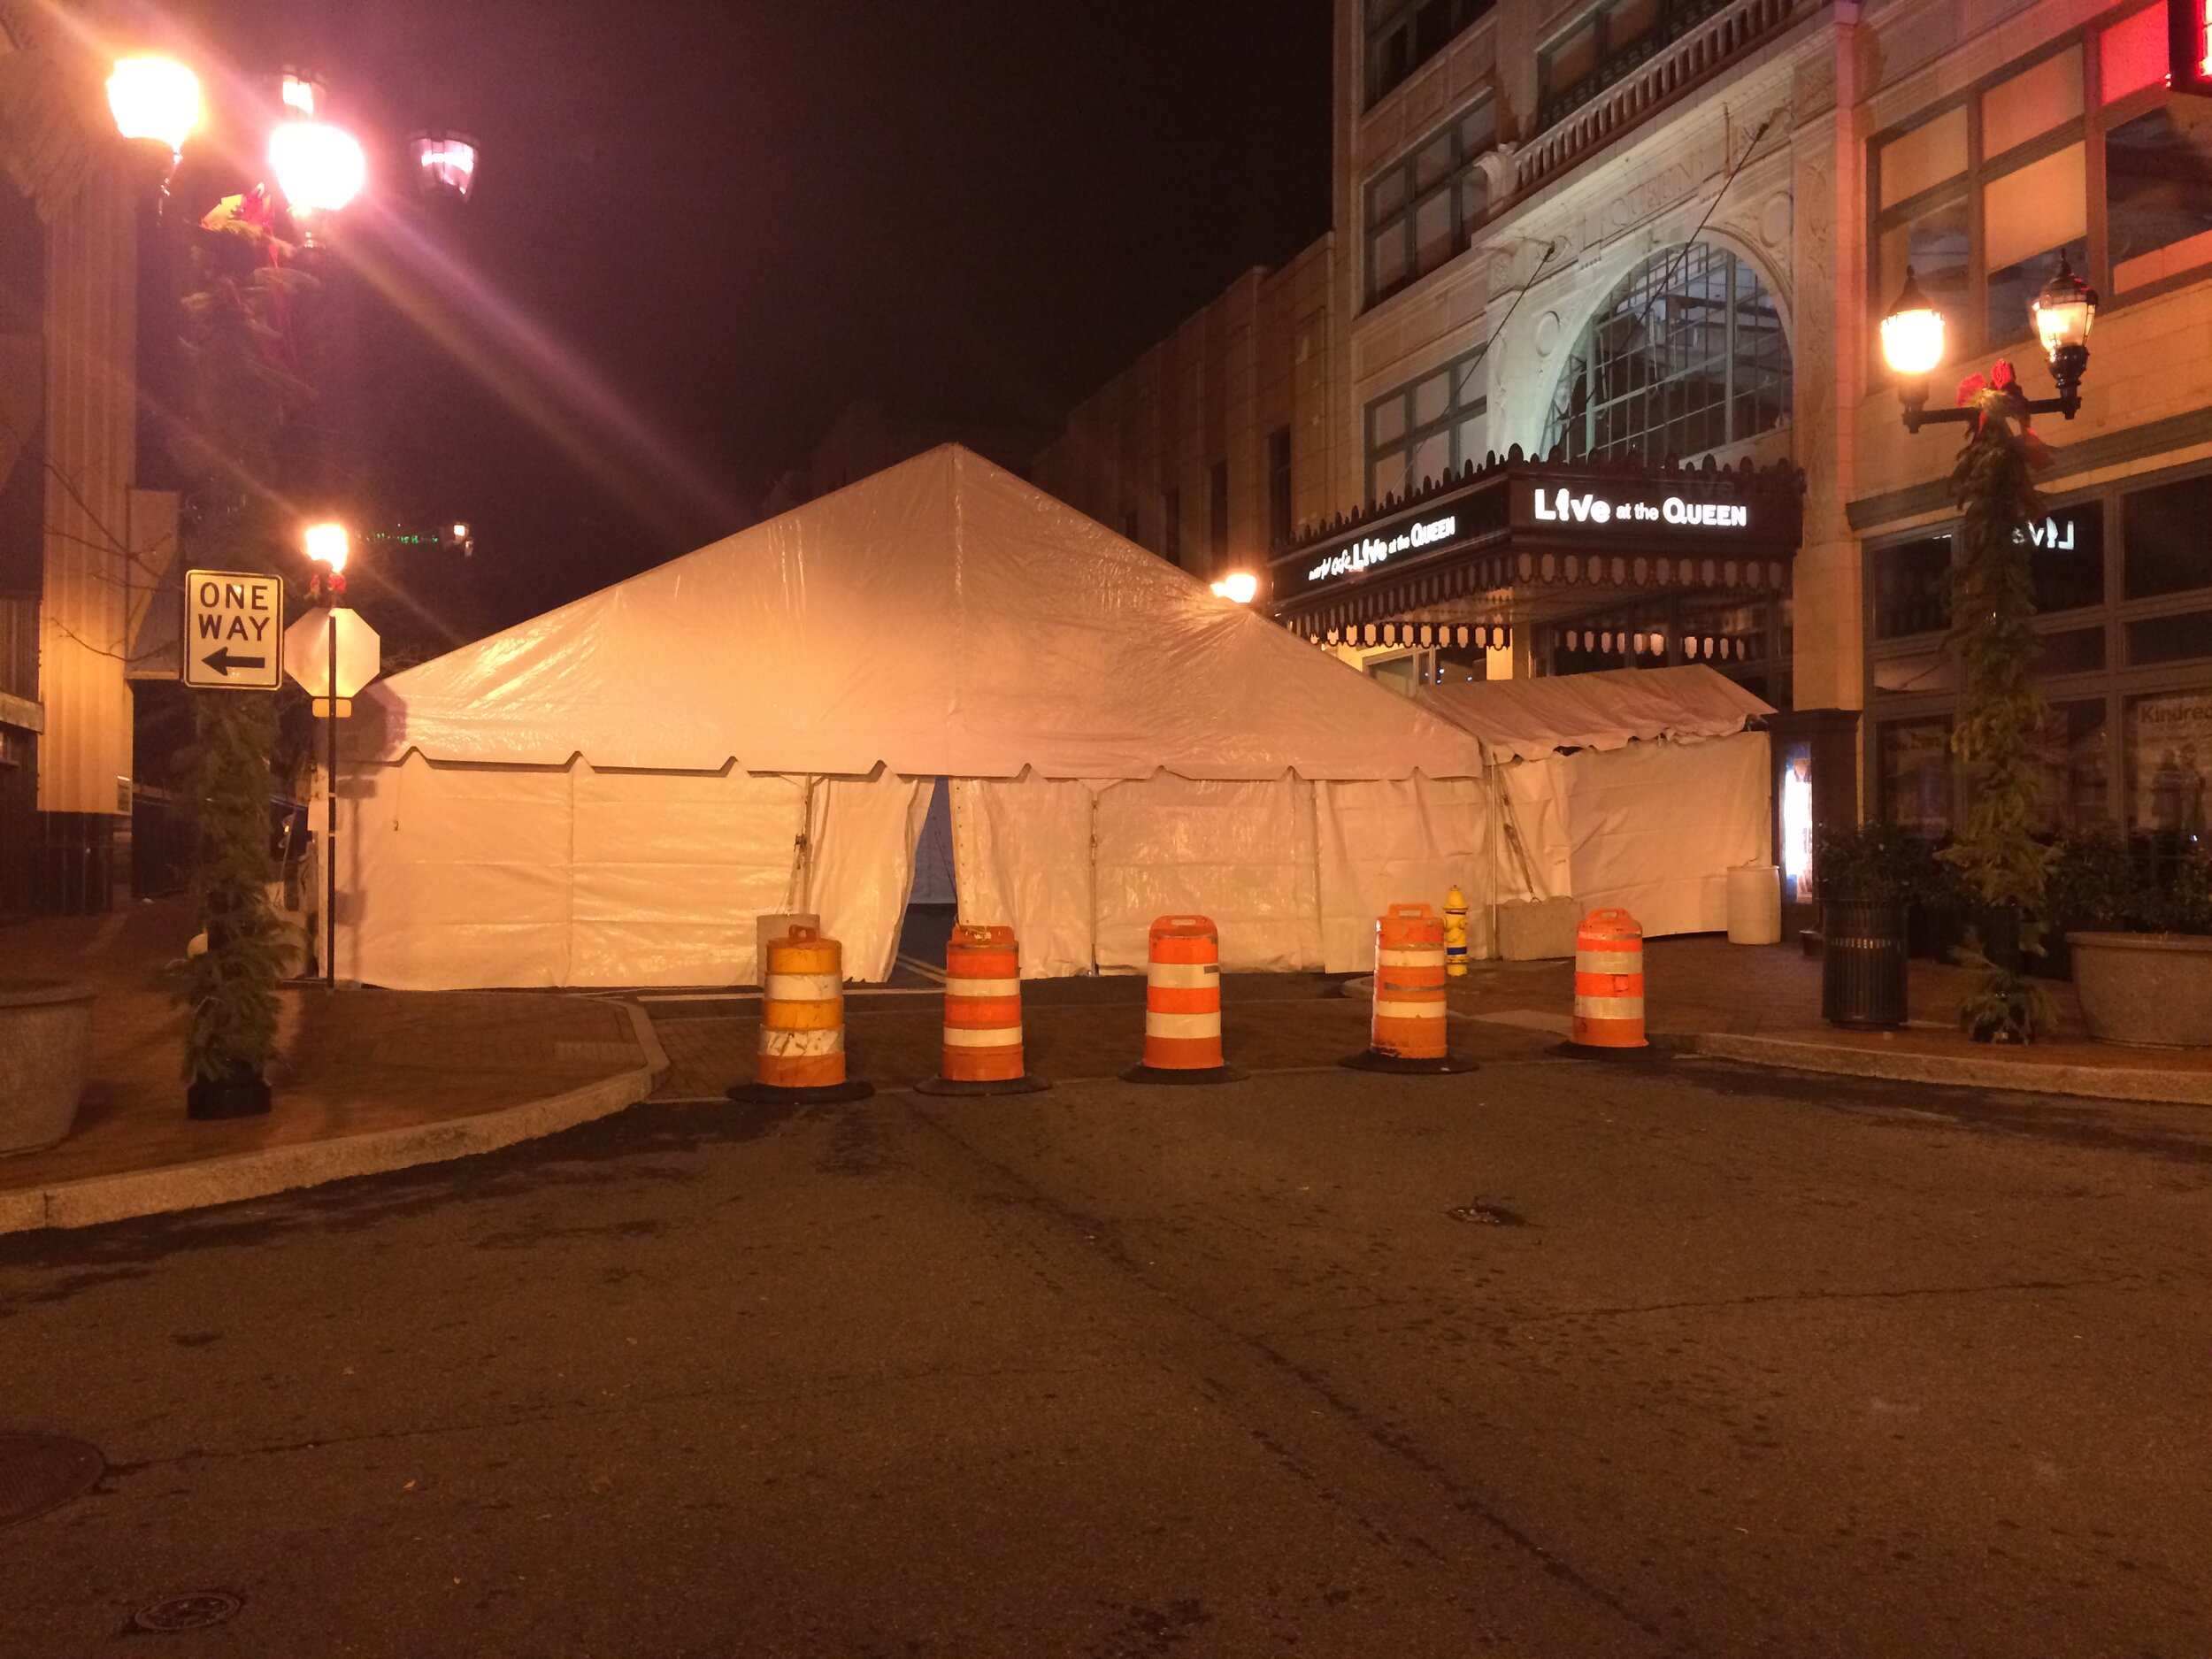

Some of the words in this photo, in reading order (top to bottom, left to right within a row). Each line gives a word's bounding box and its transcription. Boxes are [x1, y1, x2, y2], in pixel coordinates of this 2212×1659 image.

[1611, 149, 1704, 227] QUEEN
[1616, 503, 1632, 520] at
[1634, 502, 1660, 521] the
[1663, 496, 1747, 526] QUEEN
[1410, 515, 1455, 548] QUEEN
[199, 581, 269, 611] ONE
[197, 613, 271, 641] WAY
